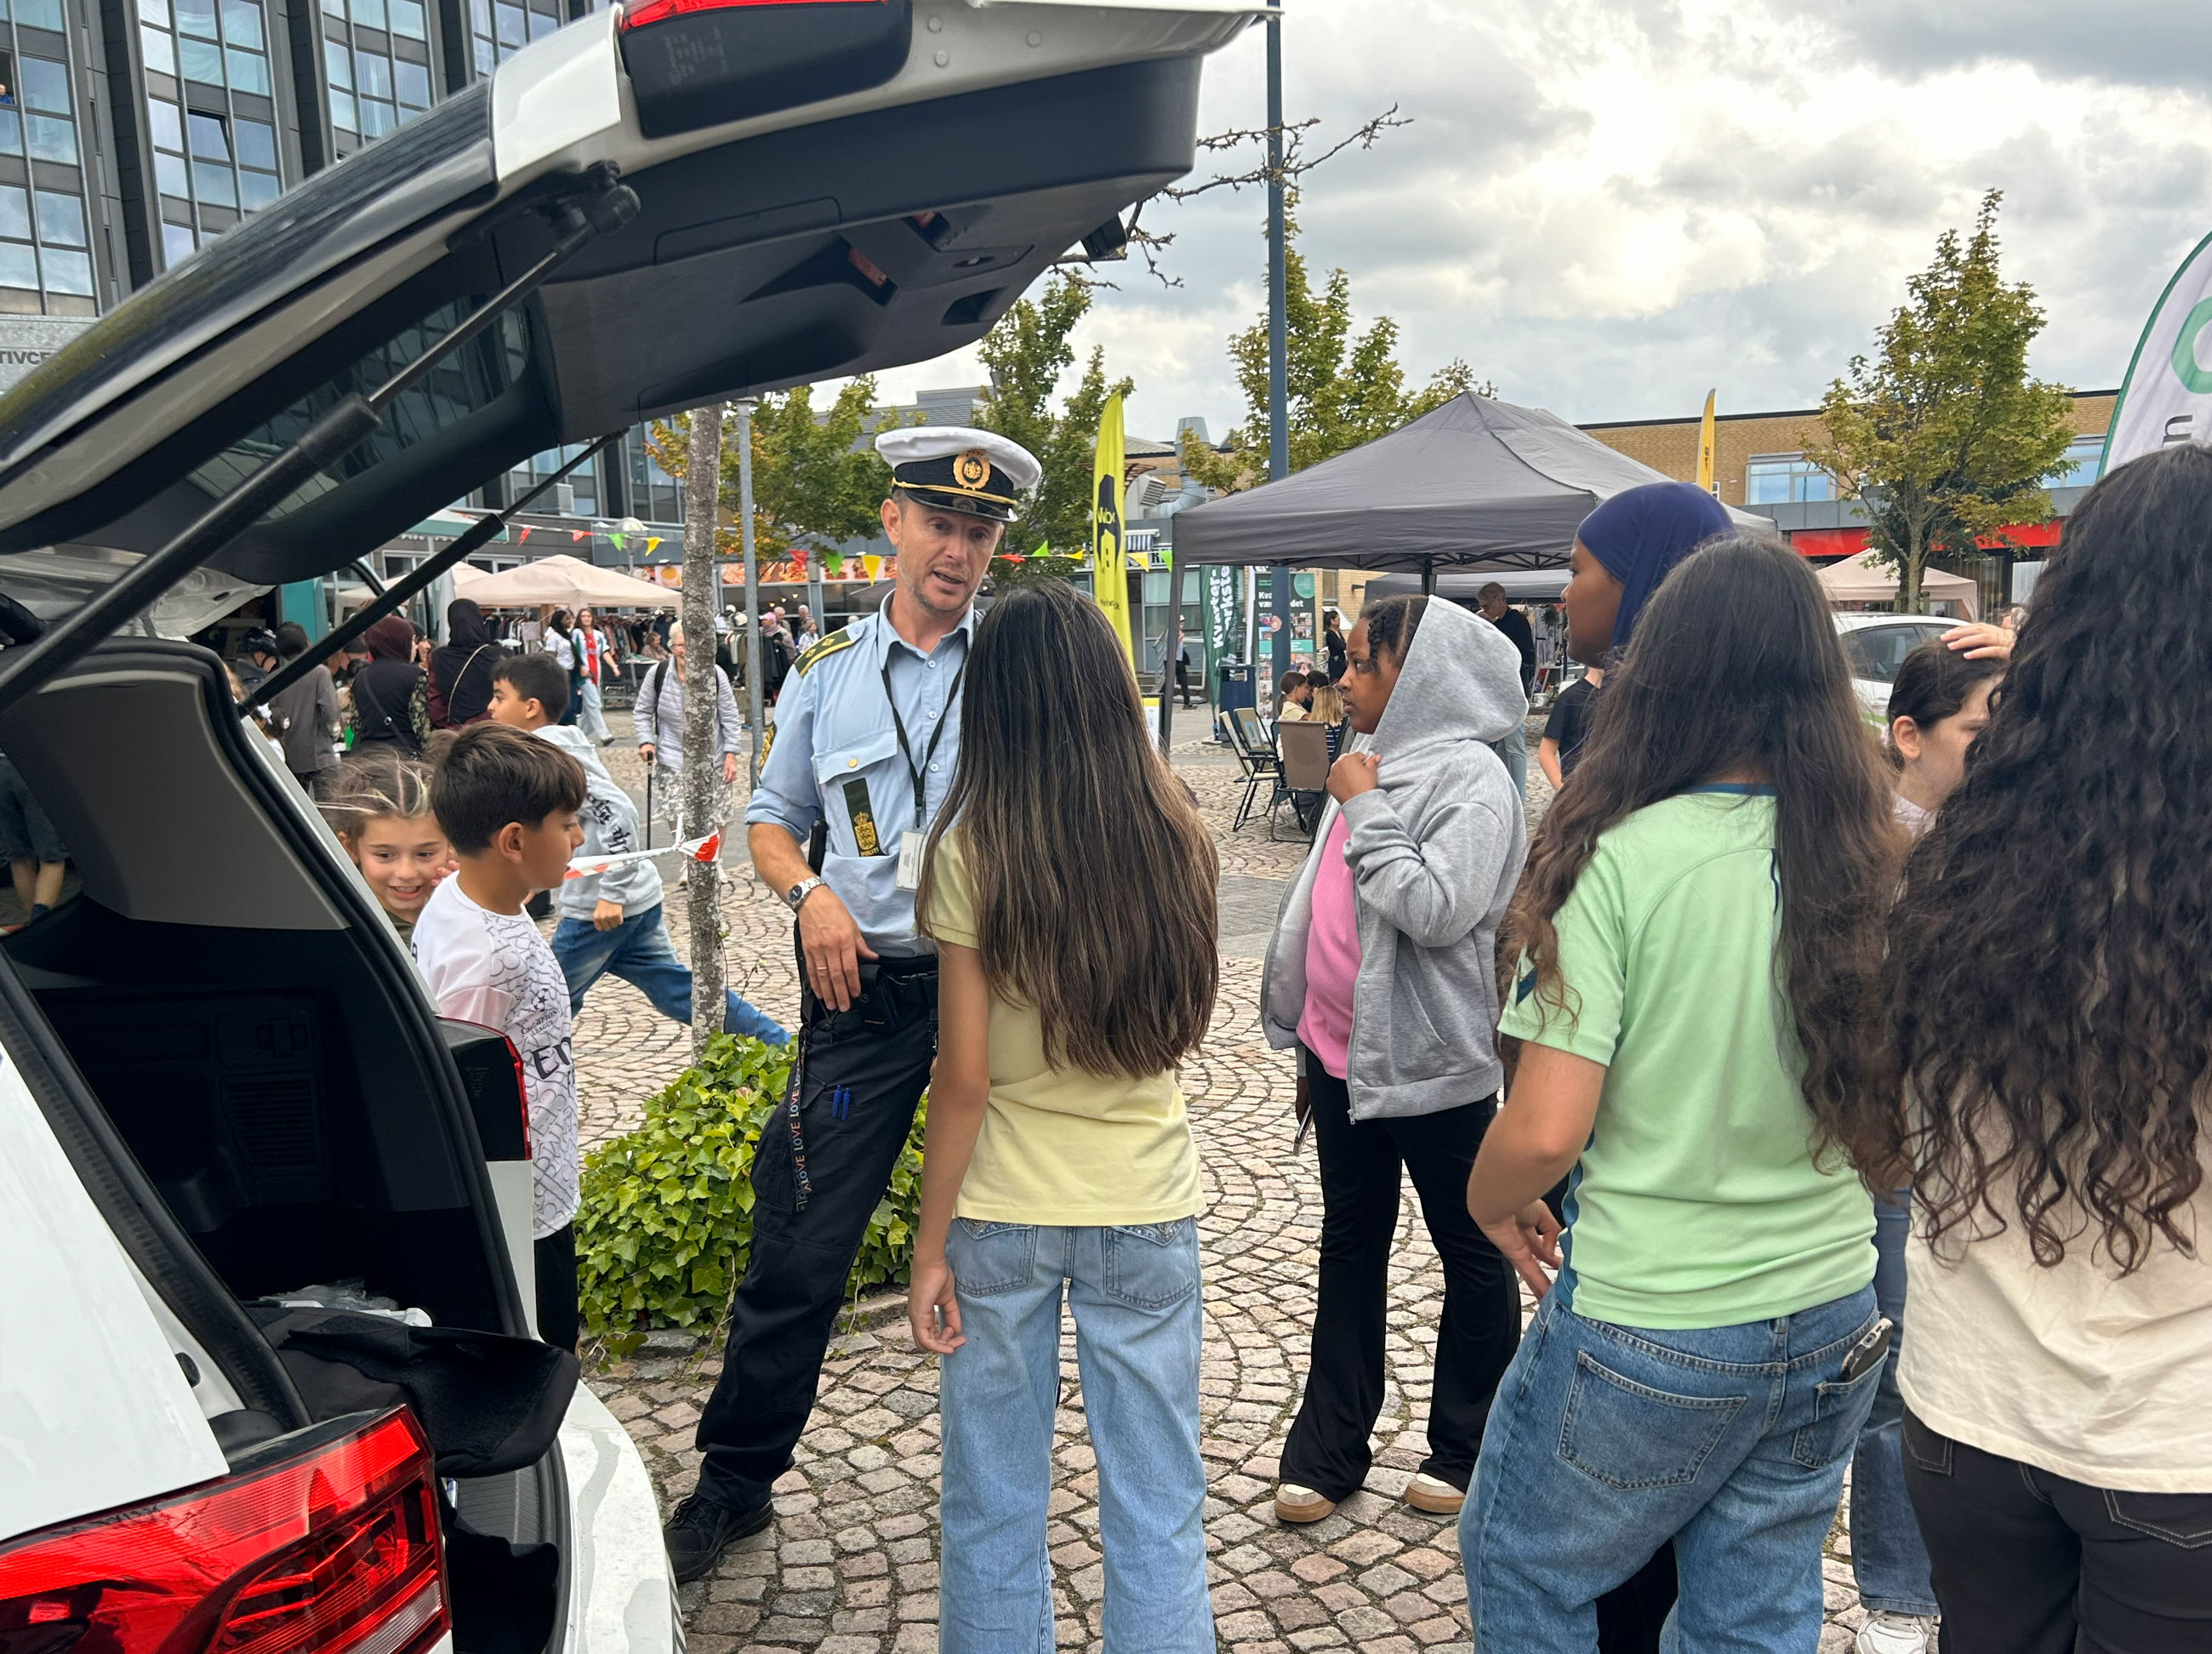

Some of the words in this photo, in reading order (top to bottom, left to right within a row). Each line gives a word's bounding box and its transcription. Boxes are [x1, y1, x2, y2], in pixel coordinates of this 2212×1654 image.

[790, 1089, 800, 1118] LOVE
[790, 1121, 804, 1151] LOVE
[795, 1155, 809, 1184] LOVE
